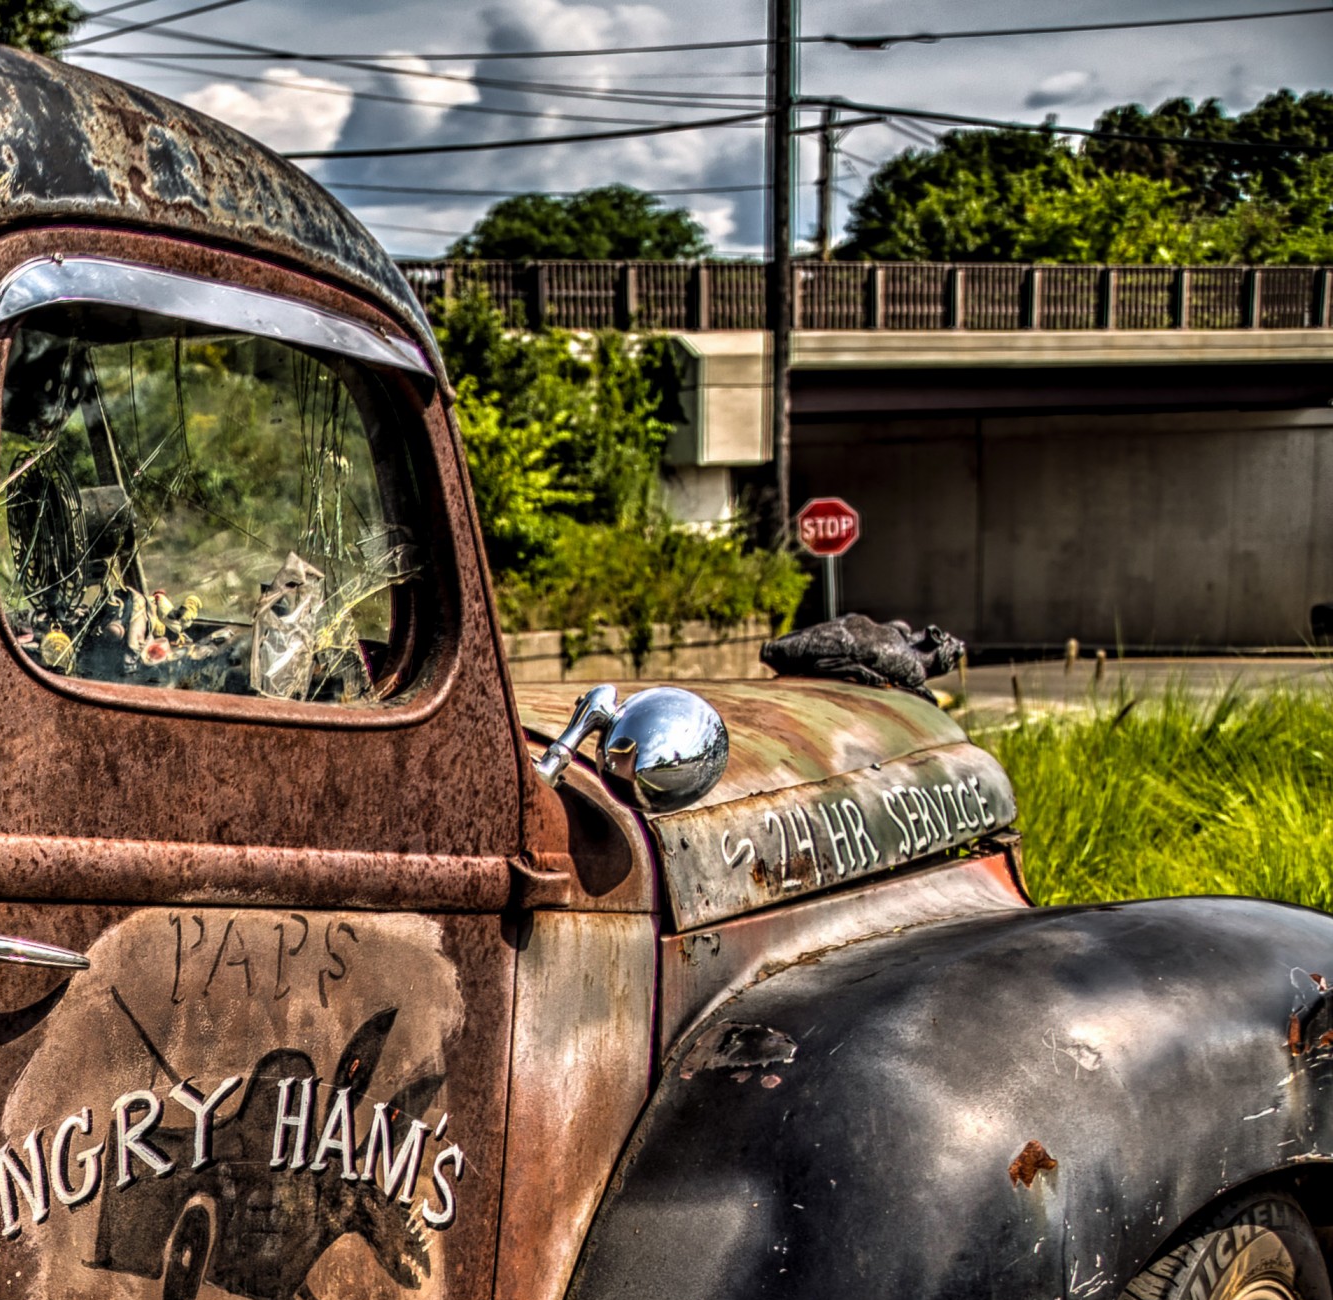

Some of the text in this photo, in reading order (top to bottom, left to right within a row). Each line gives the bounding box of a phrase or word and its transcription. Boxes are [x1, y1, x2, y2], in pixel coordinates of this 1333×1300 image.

[801, 514, 854, 539] STOP
[818, 798, 882, 876] HR
[881, 774, 996, 856] SERVICE
[269, 1076, 465, 1228] HAM'S
